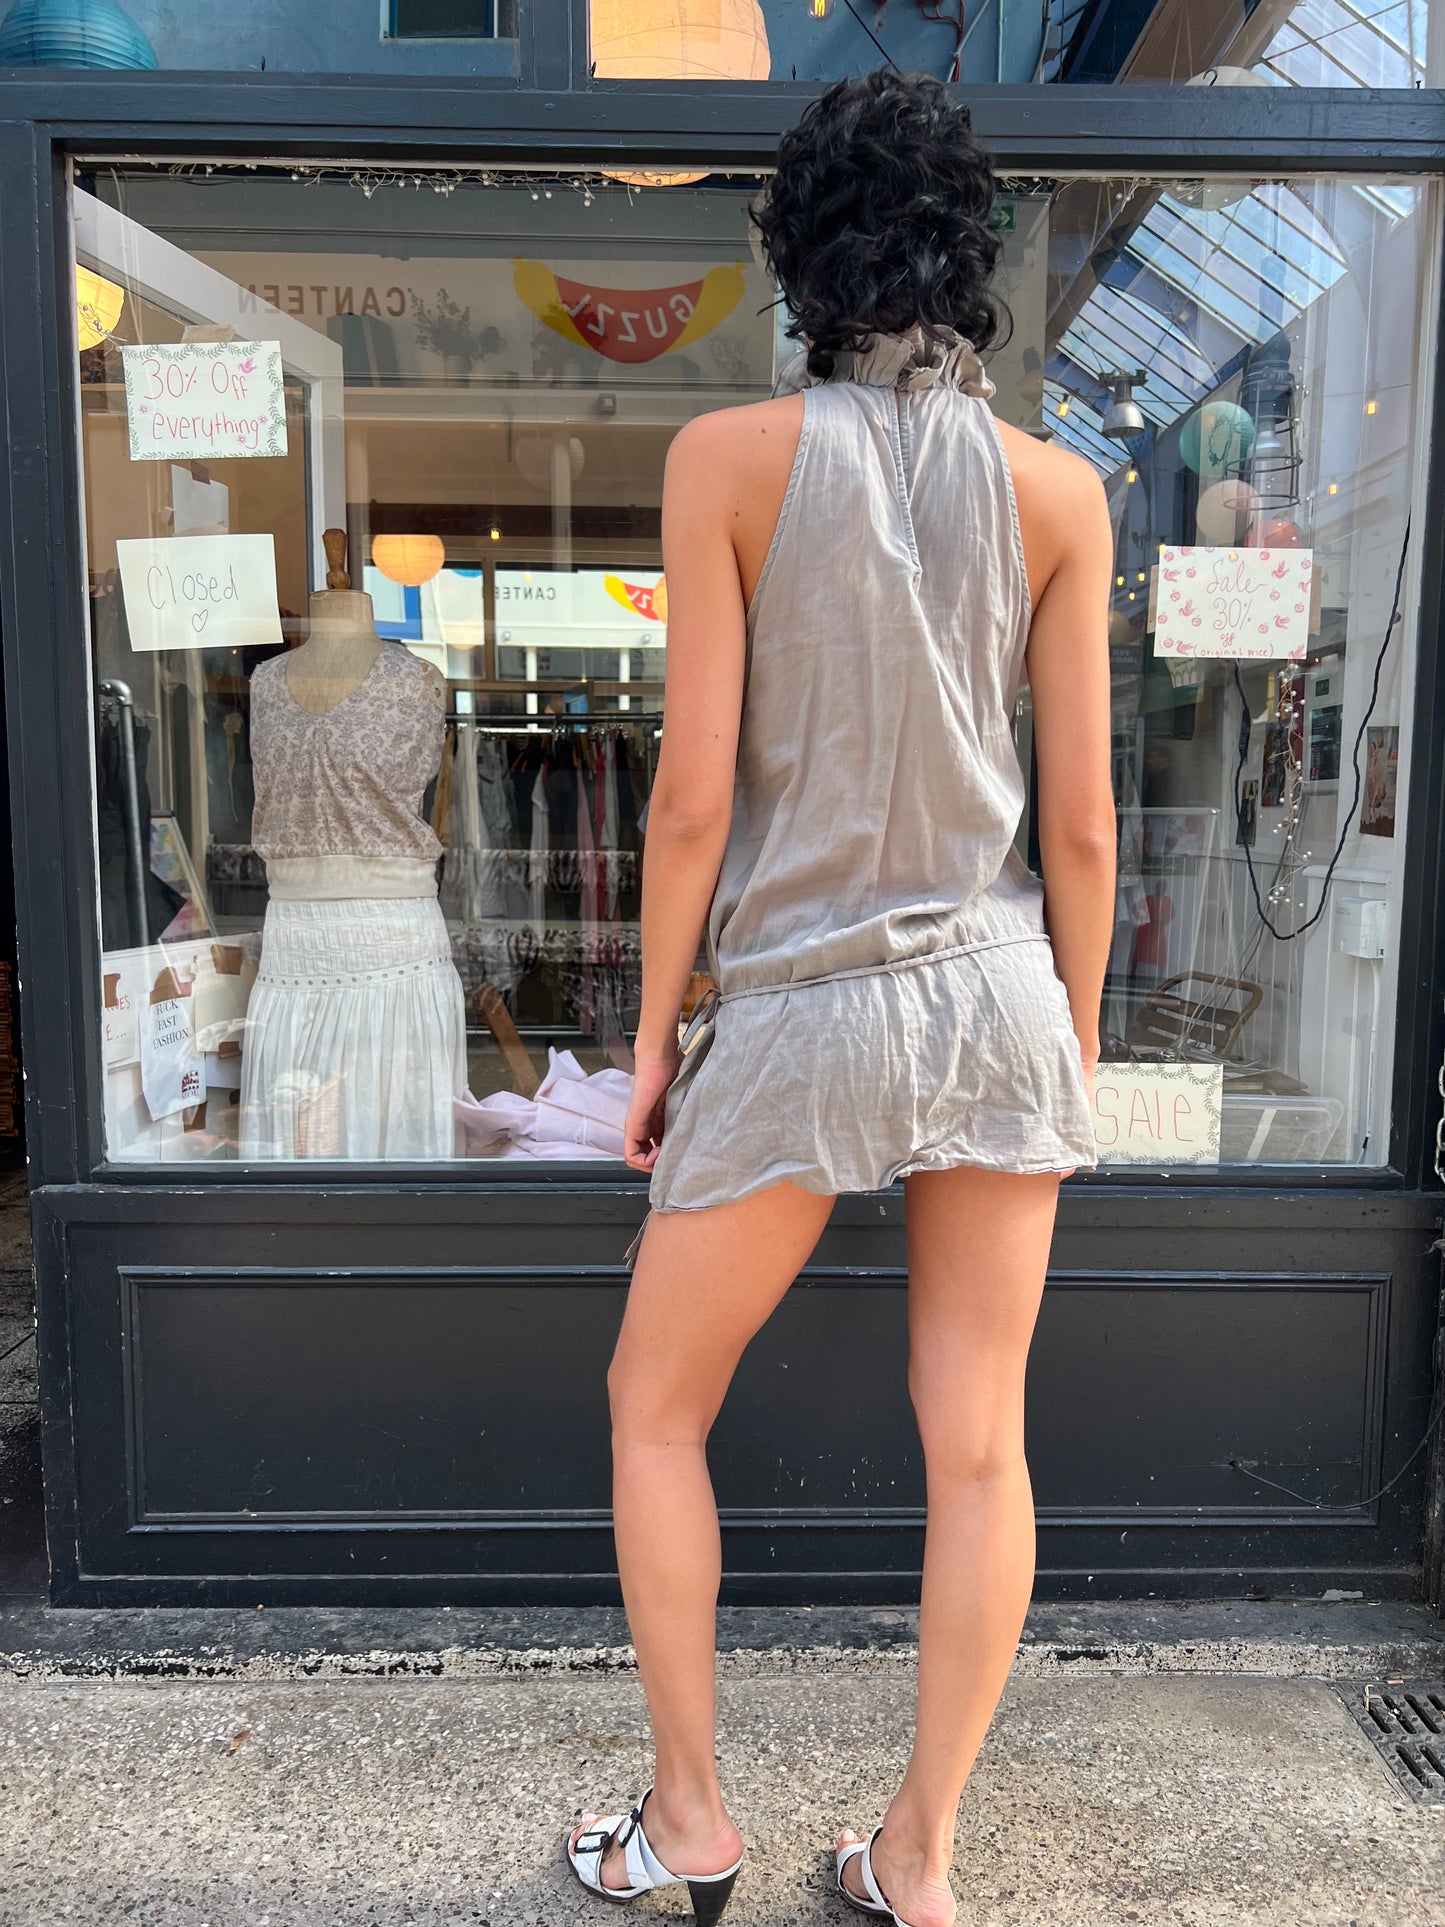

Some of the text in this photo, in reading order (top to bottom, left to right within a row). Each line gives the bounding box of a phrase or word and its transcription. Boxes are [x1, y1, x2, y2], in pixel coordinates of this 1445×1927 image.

[144, 358, 197, 400] 30%
[151, 412, 260, 450] everything
[146, 565, 240, 611] Closed
[1206, 558, 1269, 594] Sale
[1213, 597, 1254, 631] 30%
[1219, 632, 1236, 648] off
[152, 1028, 189, 1050] FASHION
[157, 1015, 178, 1031] FAST
